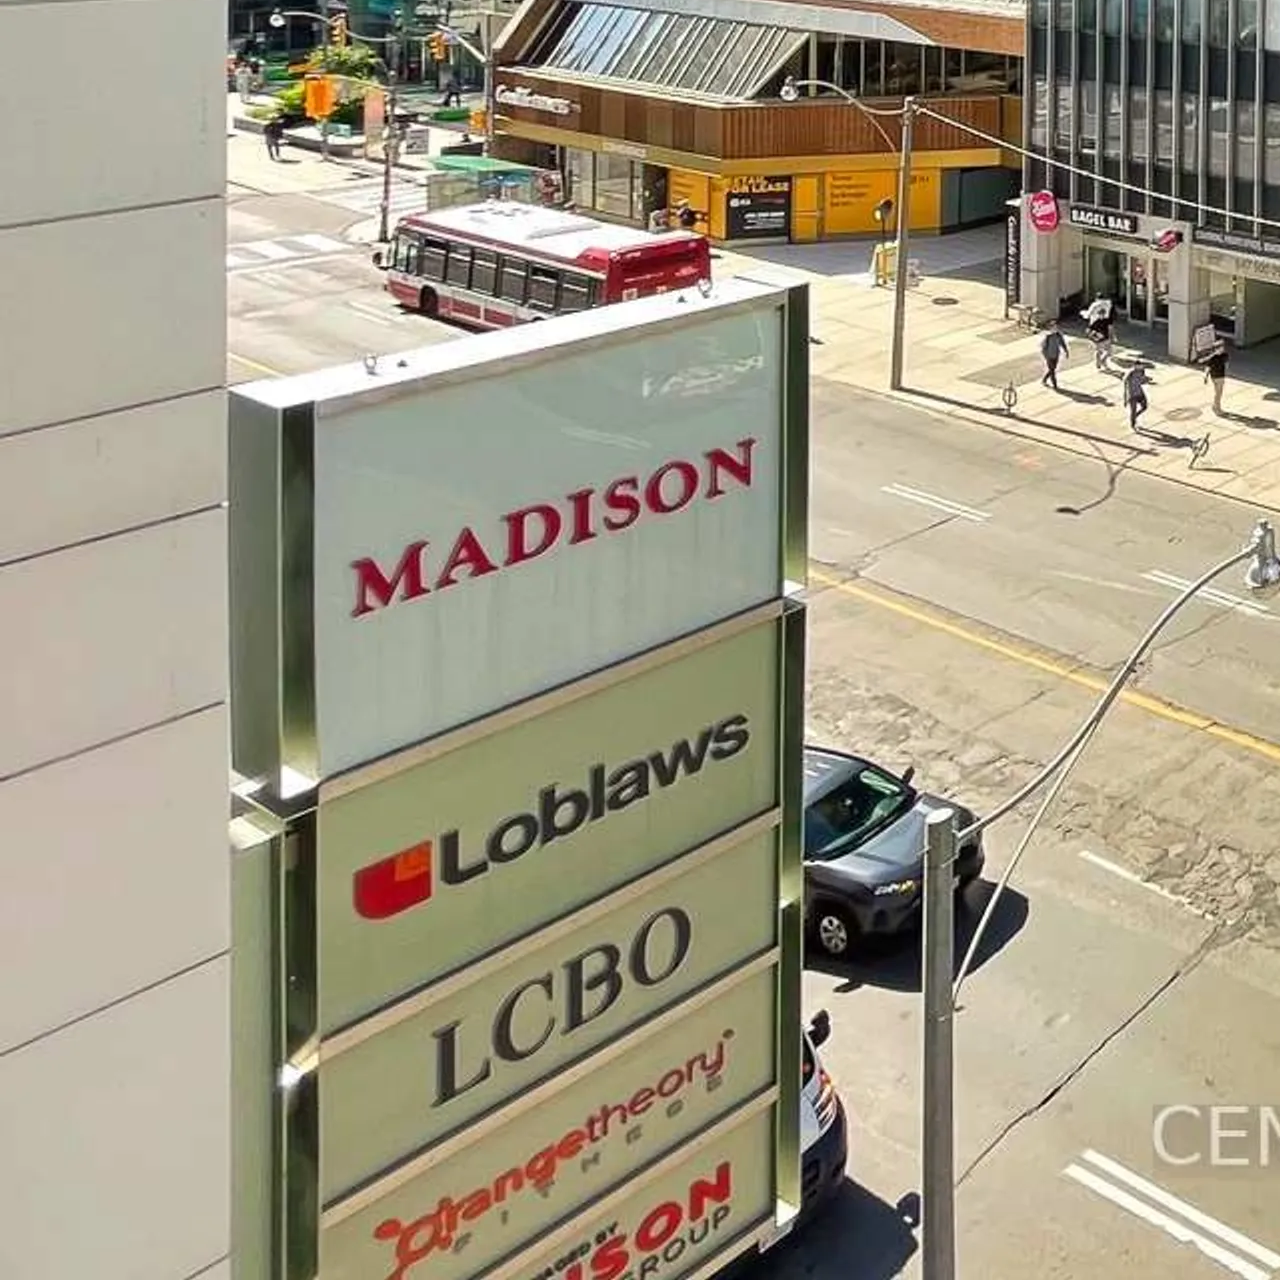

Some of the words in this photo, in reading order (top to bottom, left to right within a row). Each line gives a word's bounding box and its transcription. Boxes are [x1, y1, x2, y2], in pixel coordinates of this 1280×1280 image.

[1072, 209, 1106, 228] BAGEL
[1108, 216, 1131, 232] BAR
[349, 438, 757, 618] MADISON
[439, 713, 749, 886] Loblaws
[430, 906, 692, 1108] LCBO
[622, 1204, 731, 1280] ROUP
